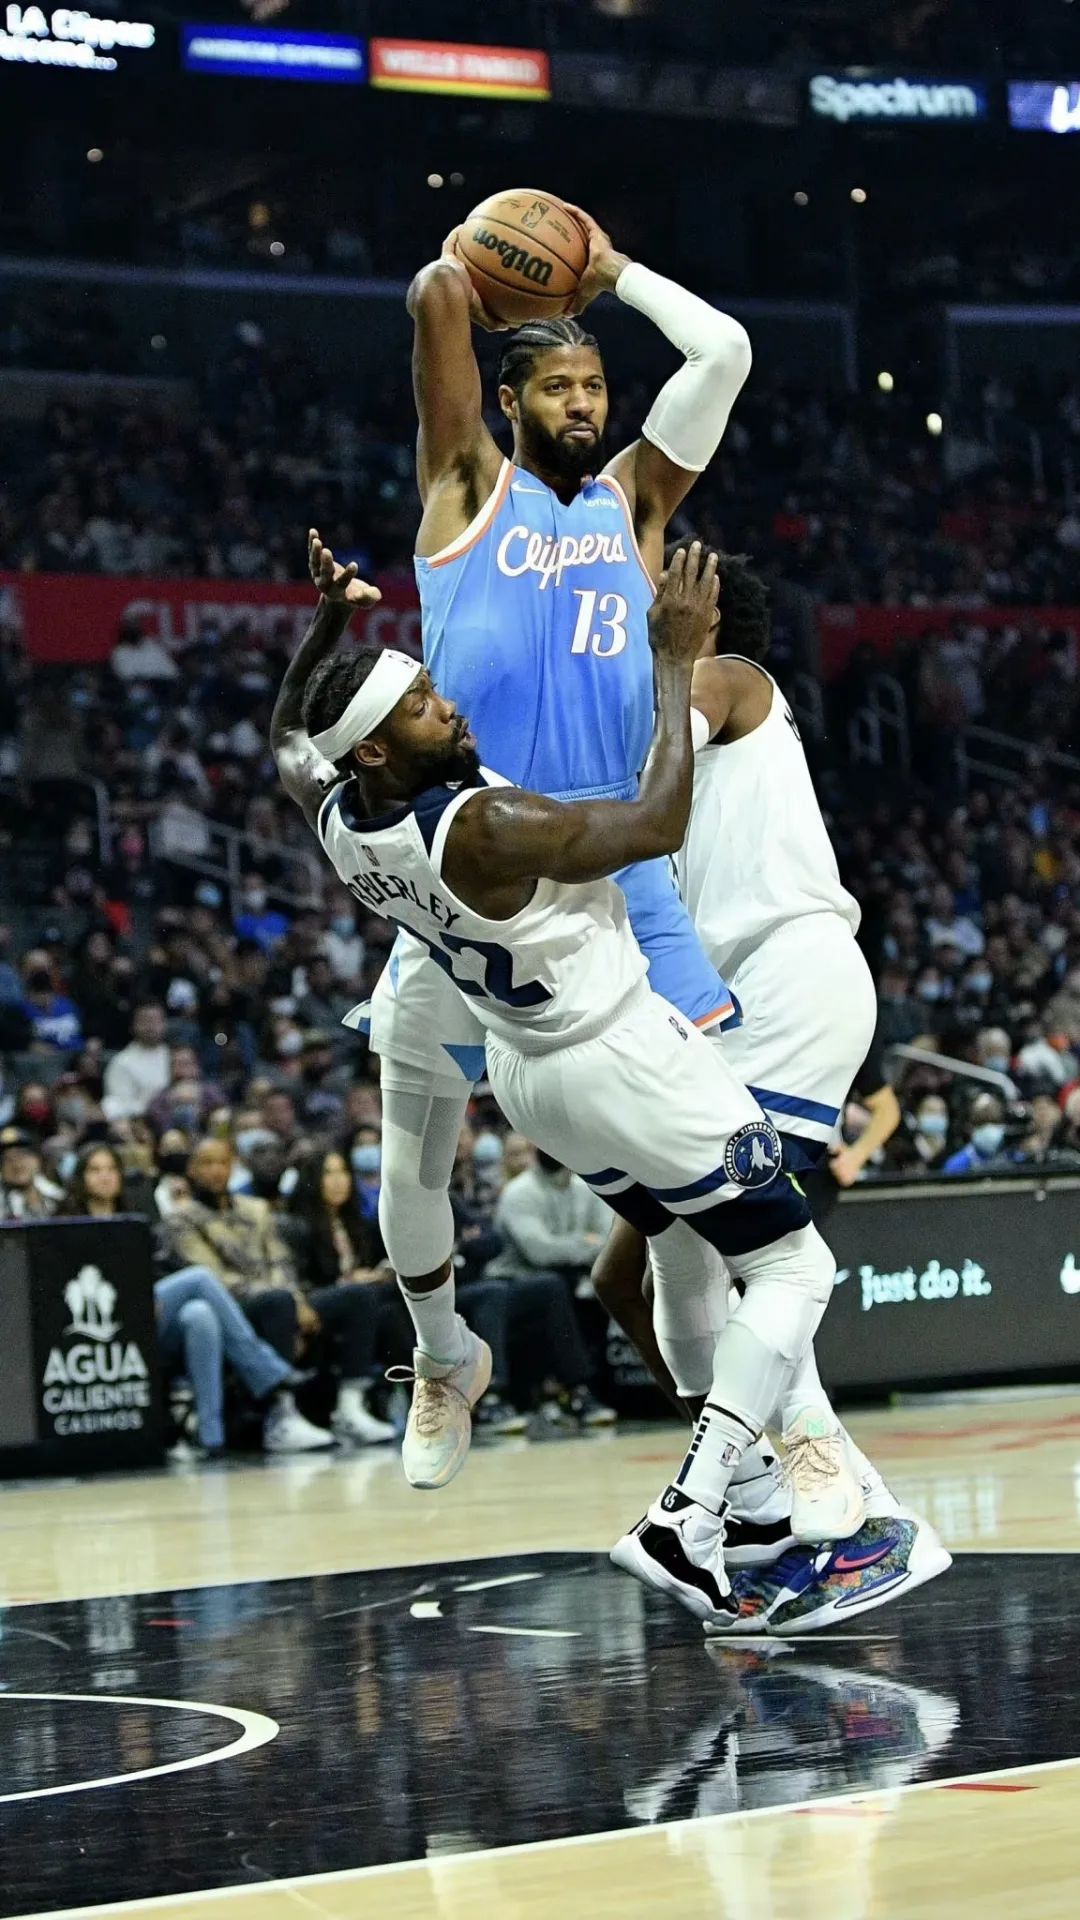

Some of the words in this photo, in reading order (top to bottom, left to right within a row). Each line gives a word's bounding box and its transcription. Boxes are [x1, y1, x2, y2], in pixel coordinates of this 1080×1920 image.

[6, 4, 49, 37] LA
[809, 75, 978, 122] Spectrum
[472, 227, 553, 287] Wilson
[496, 525, 628, 590] Clippers
[570, 588, 629, 658] 13
[919, 1259, 959, 1299] do
[42, 1341, 149, 1386] AGUA
[42, 1380, 152, 1415] CALIENTE
[53, 1409, 144, 1436] CASINOS
